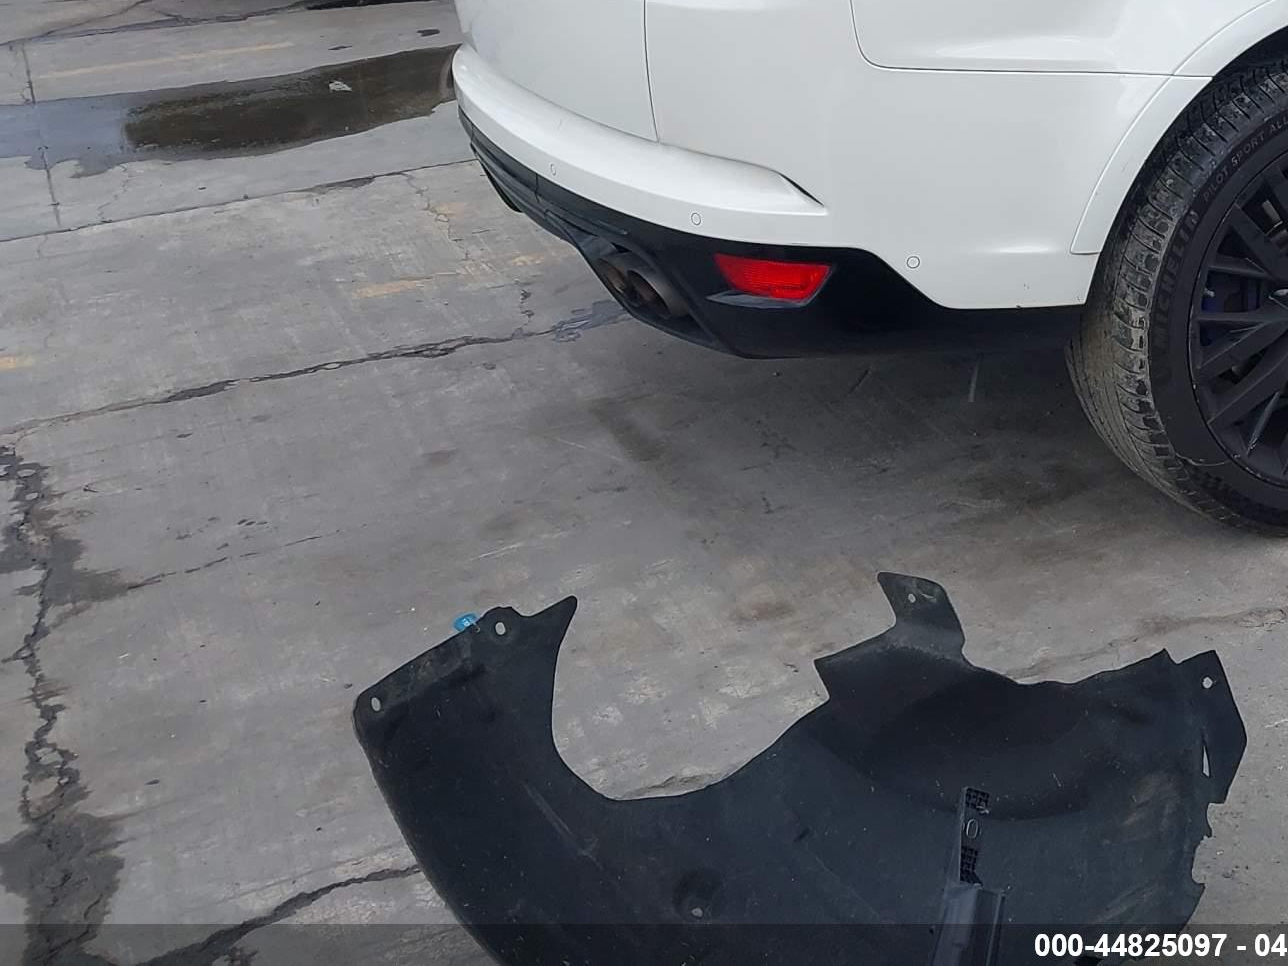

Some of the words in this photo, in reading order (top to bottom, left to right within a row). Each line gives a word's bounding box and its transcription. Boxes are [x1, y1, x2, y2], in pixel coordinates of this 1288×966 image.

[1203, 167, 1230, 202] PILOT
[1231, 131, 1265, 167] SPORT
[1270, 117, 1288, 133] ALL
